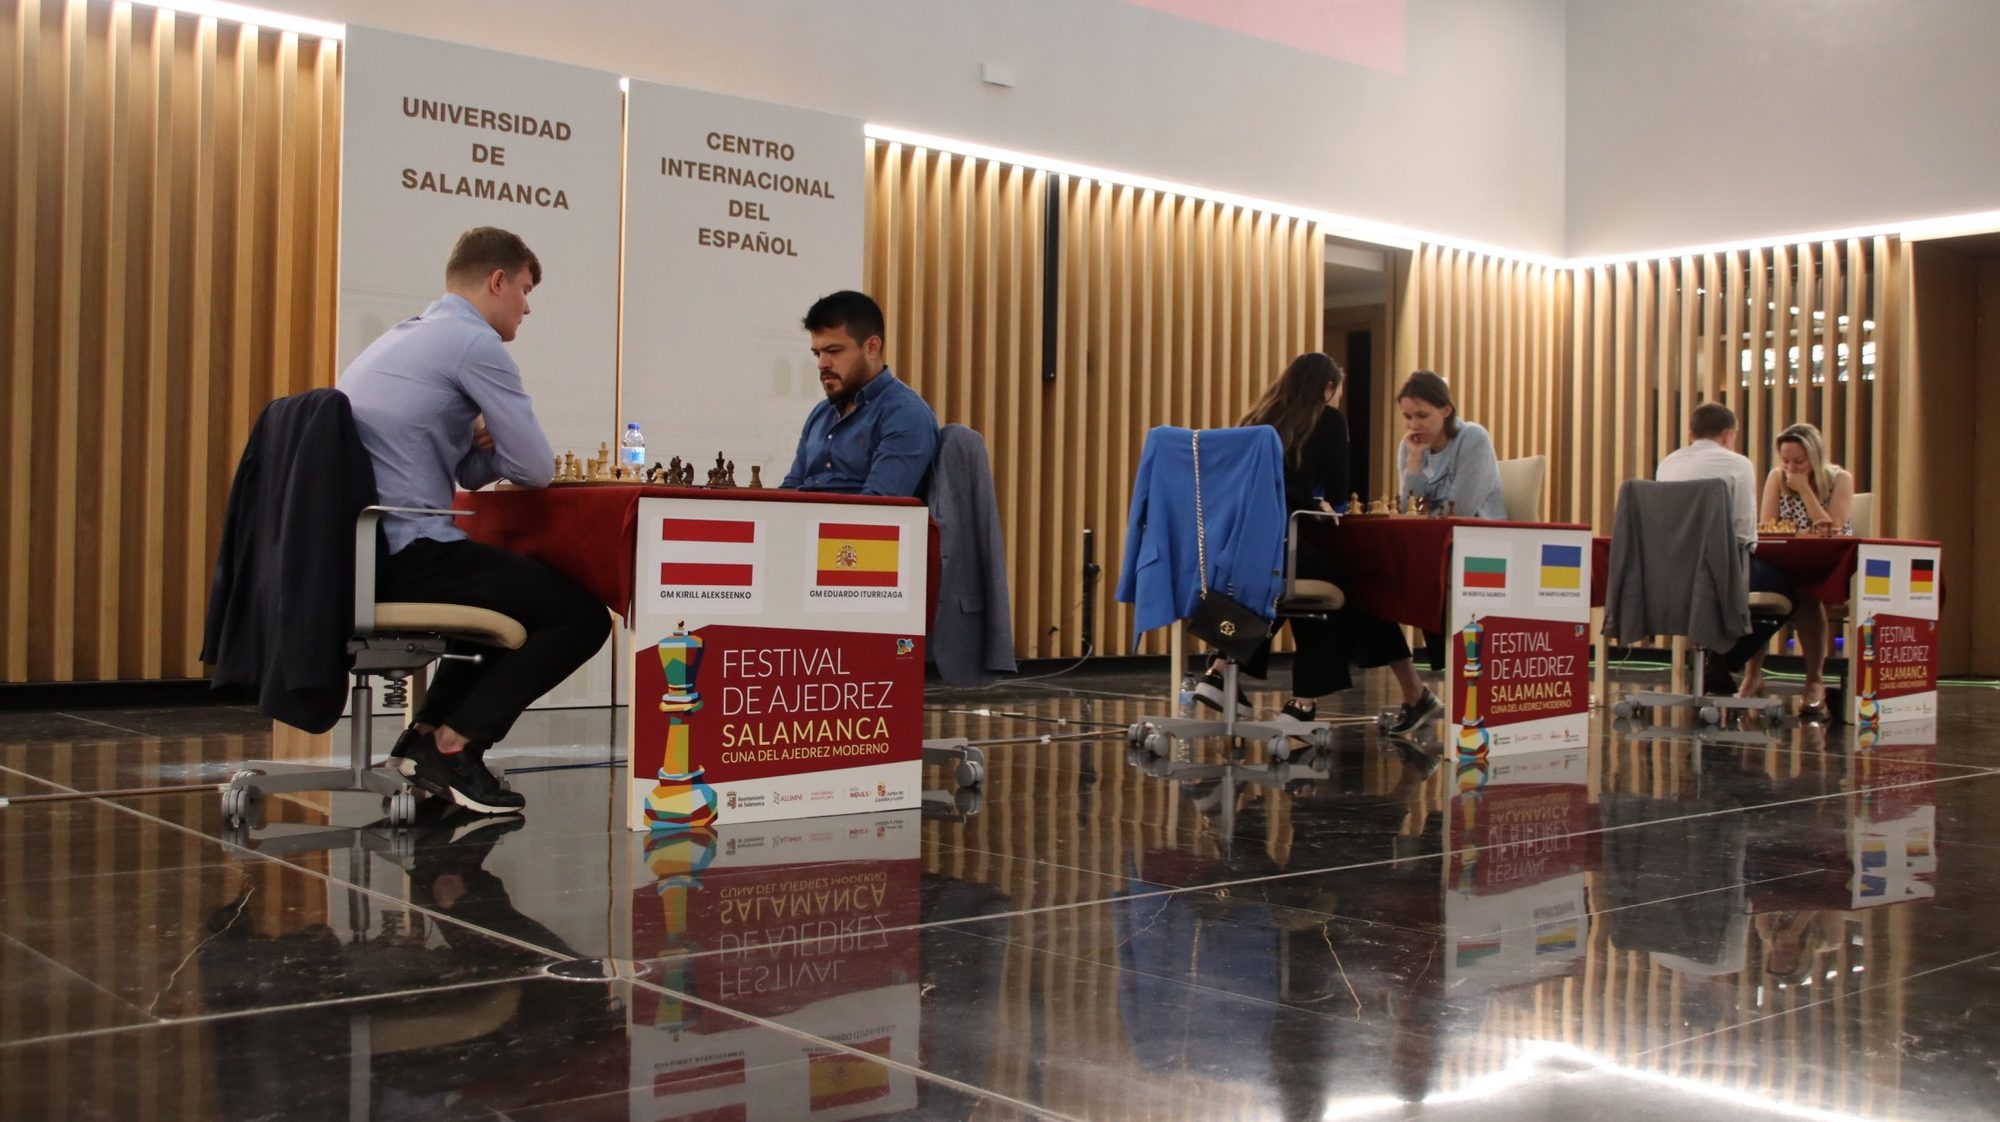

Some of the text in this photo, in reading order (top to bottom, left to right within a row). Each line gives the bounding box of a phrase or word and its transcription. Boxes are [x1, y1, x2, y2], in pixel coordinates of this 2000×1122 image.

[402, 97, 572, 142] UNIVERSIDAD
[472, 144, 505, 167] DE
[706, 132, 795, 161] CENTRO
[401, 168, 570, 210] SALAMANCA
[661, 157, 835, 199] INTERNACIONAL
[728, 199, 770, 221] DEL
[698, 227, 798, 257] ESPAÑOL
[660, 590, 752, 600] GM KIRILL ALEKSEENKO
[809, 589, 903, 599] GM EDUARDO ITURRIZAGA
[1491, 632, 1553, 654] FESTIVAL
[1880, 626, 1917, 643] FESTIVAL
[722, 647, 850, 678] FESTIVAL
[1880, 645, 1929, 664] DE AJEDREZ
[1491, 655, 1575, 680] DE AJEDREZ
[1880, 665, 1928, 681] SALAMANCA
[722, 681, 894, 716] DE AJEDREZ
[1491, 681, 1572, 703] SALAMANCA
[721, 716, 890, 749] SALAMANCA
[721, 742, 889, 765] CUNA DEL AJEDREZ MODERNO
